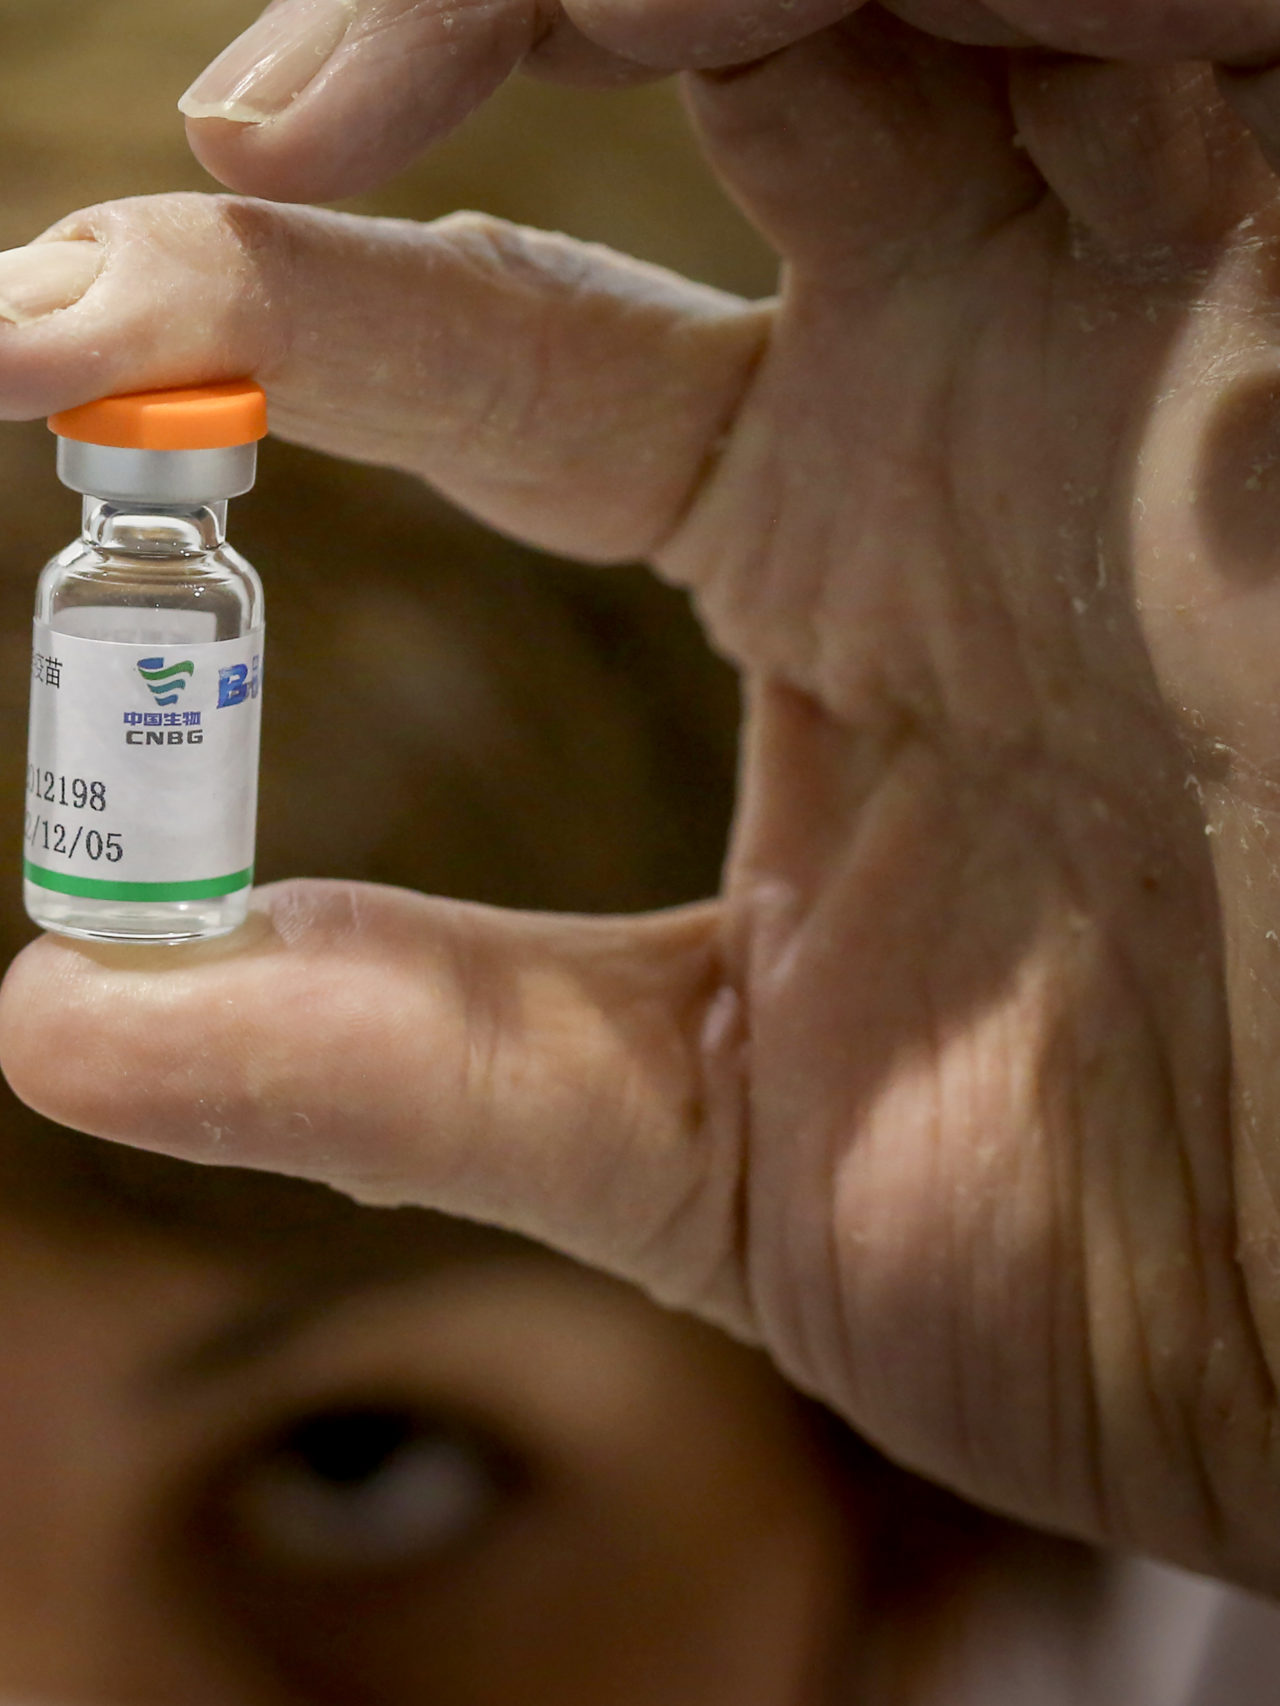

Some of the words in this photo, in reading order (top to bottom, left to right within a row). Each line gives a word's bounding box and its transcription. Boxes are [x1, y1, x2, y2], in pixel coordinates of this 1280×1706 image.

[123, 711, 201, 727] 中国生物
[125, 729, 203, 746] CNBG
